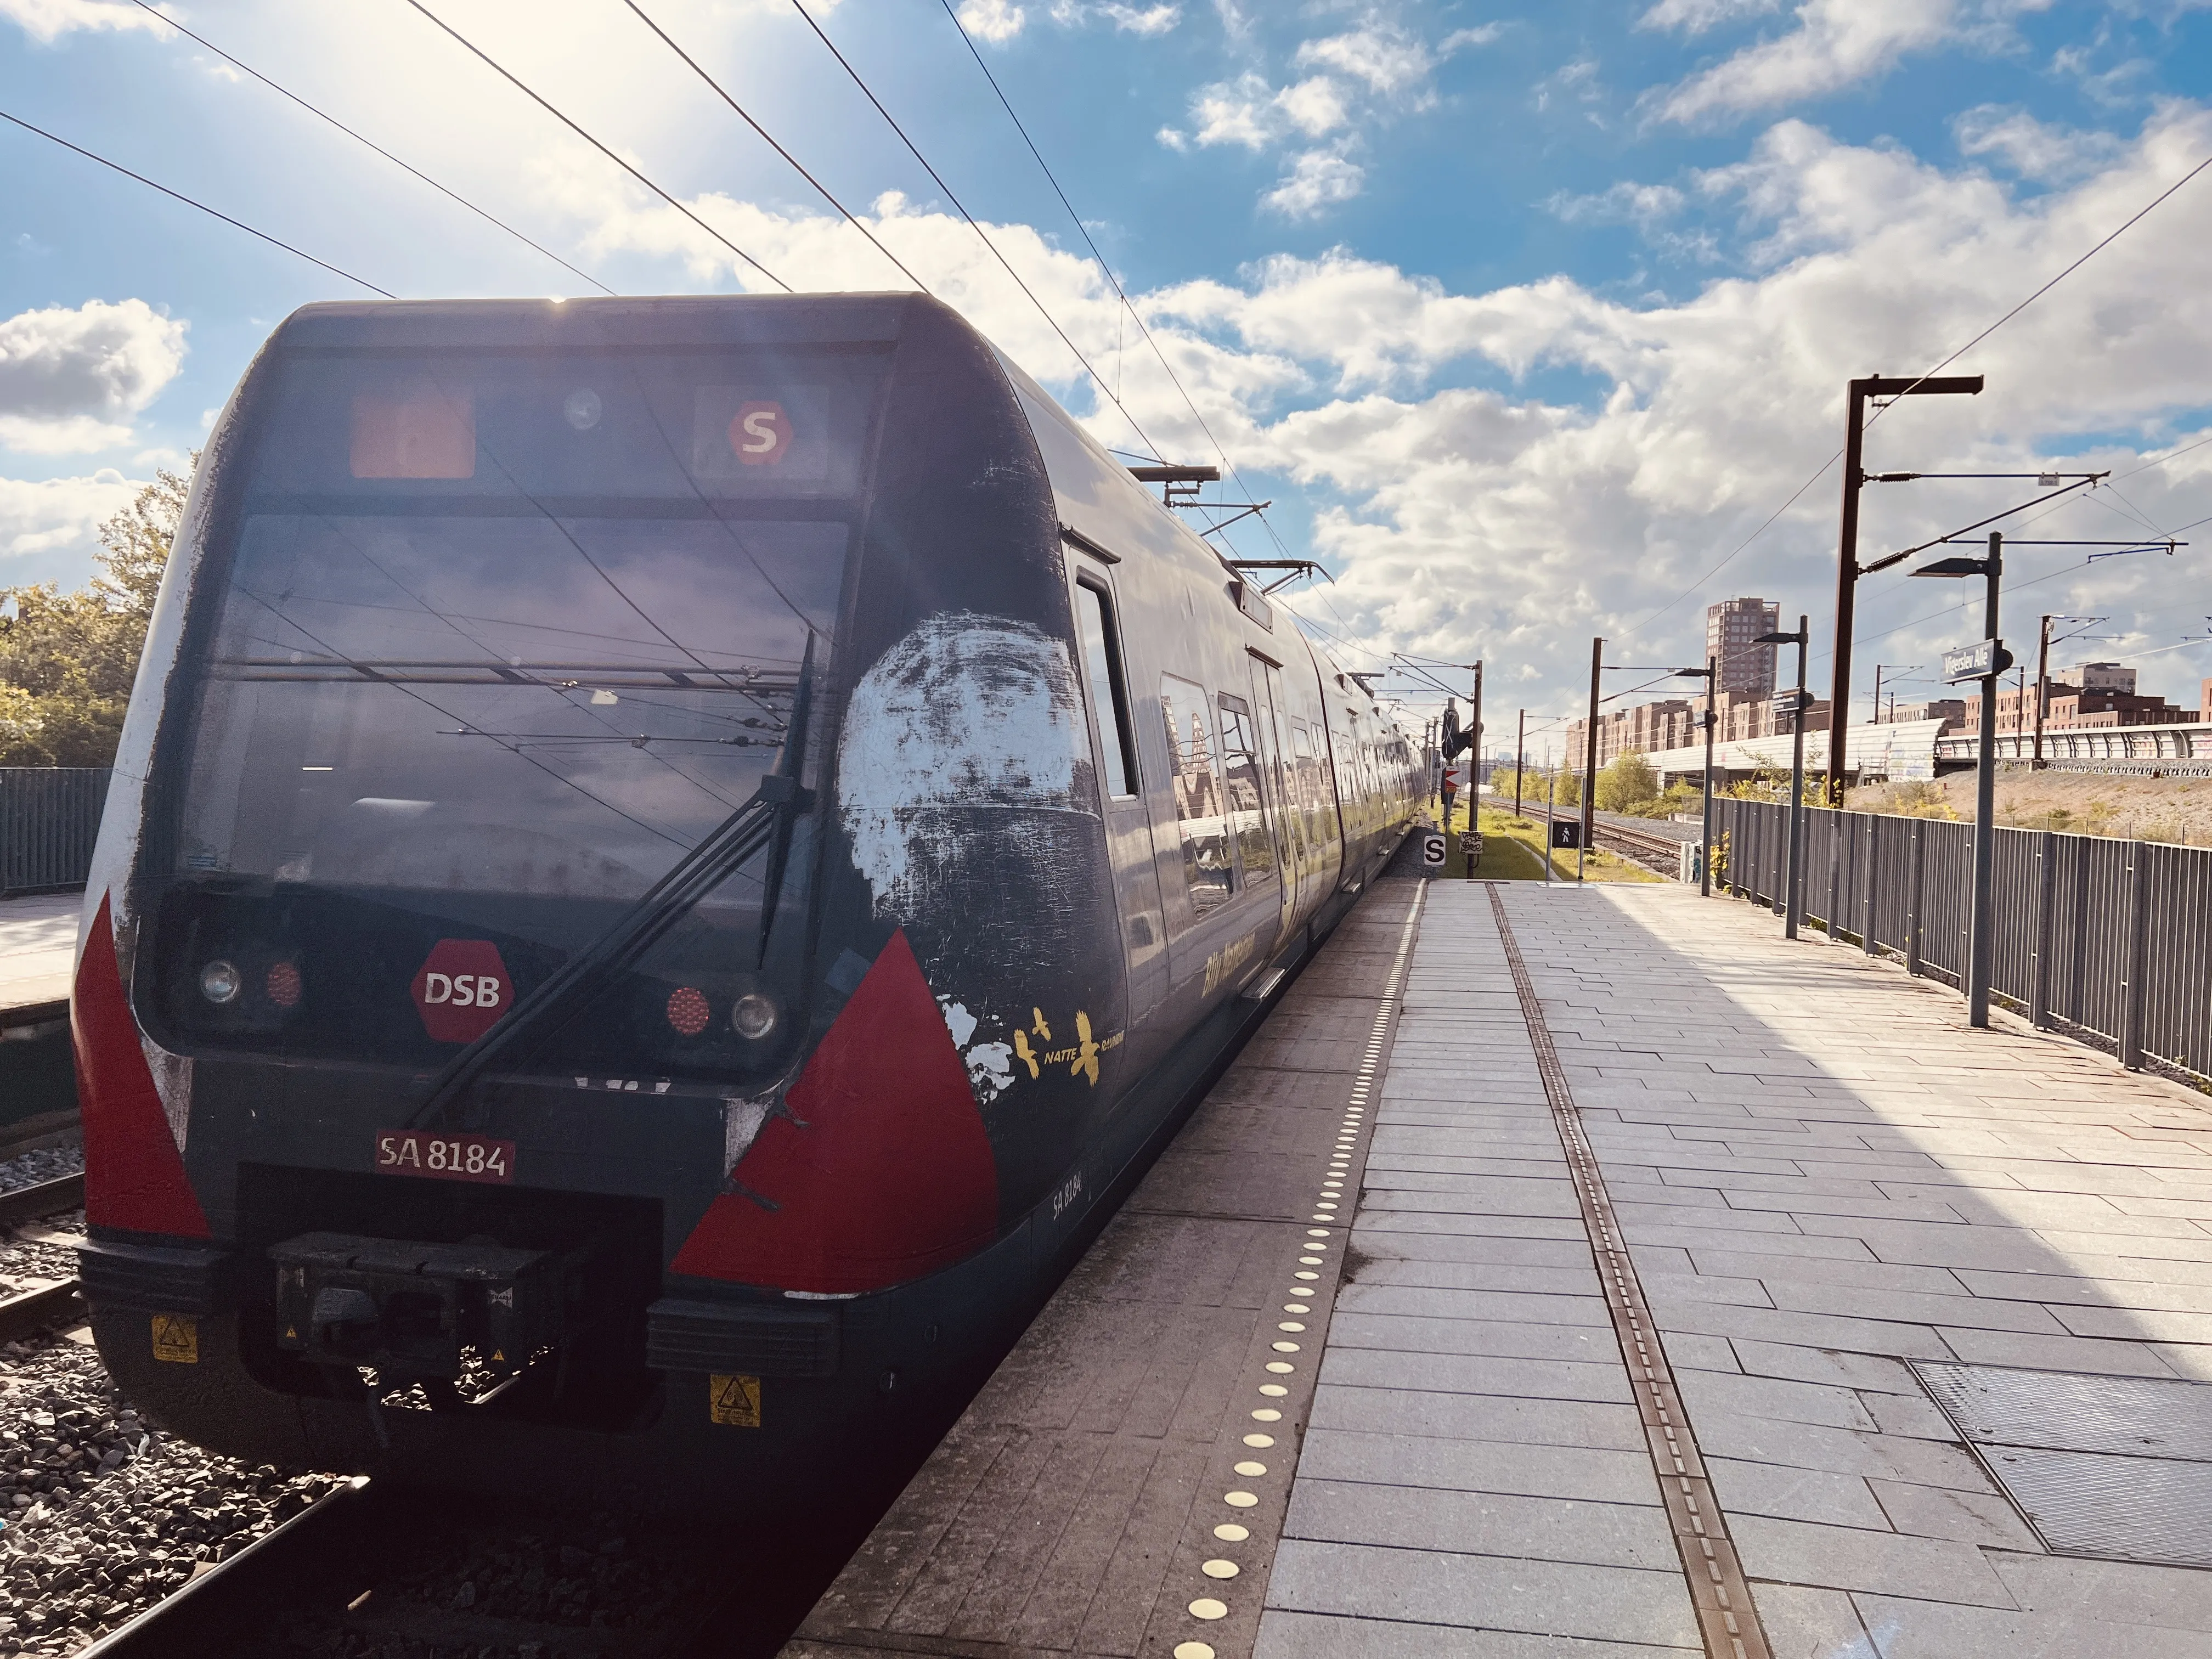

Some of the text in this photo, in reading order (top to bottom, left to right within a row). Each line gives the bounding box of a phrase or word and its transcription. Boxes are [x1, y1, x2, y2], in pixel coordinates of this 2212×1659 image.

[742, 412, 777, 453] S
[1945, 647, 1988, 675] Vigerslev Allé
[1425, 839, 1444, 862] S
[424, 973, 500, 1008] DSB
[1044, 1047, 1077, 1065] NATTE
[380, 1136, 506, 1177] SA 8184
[1053, 1170, 1081, 1221] SA 8184
